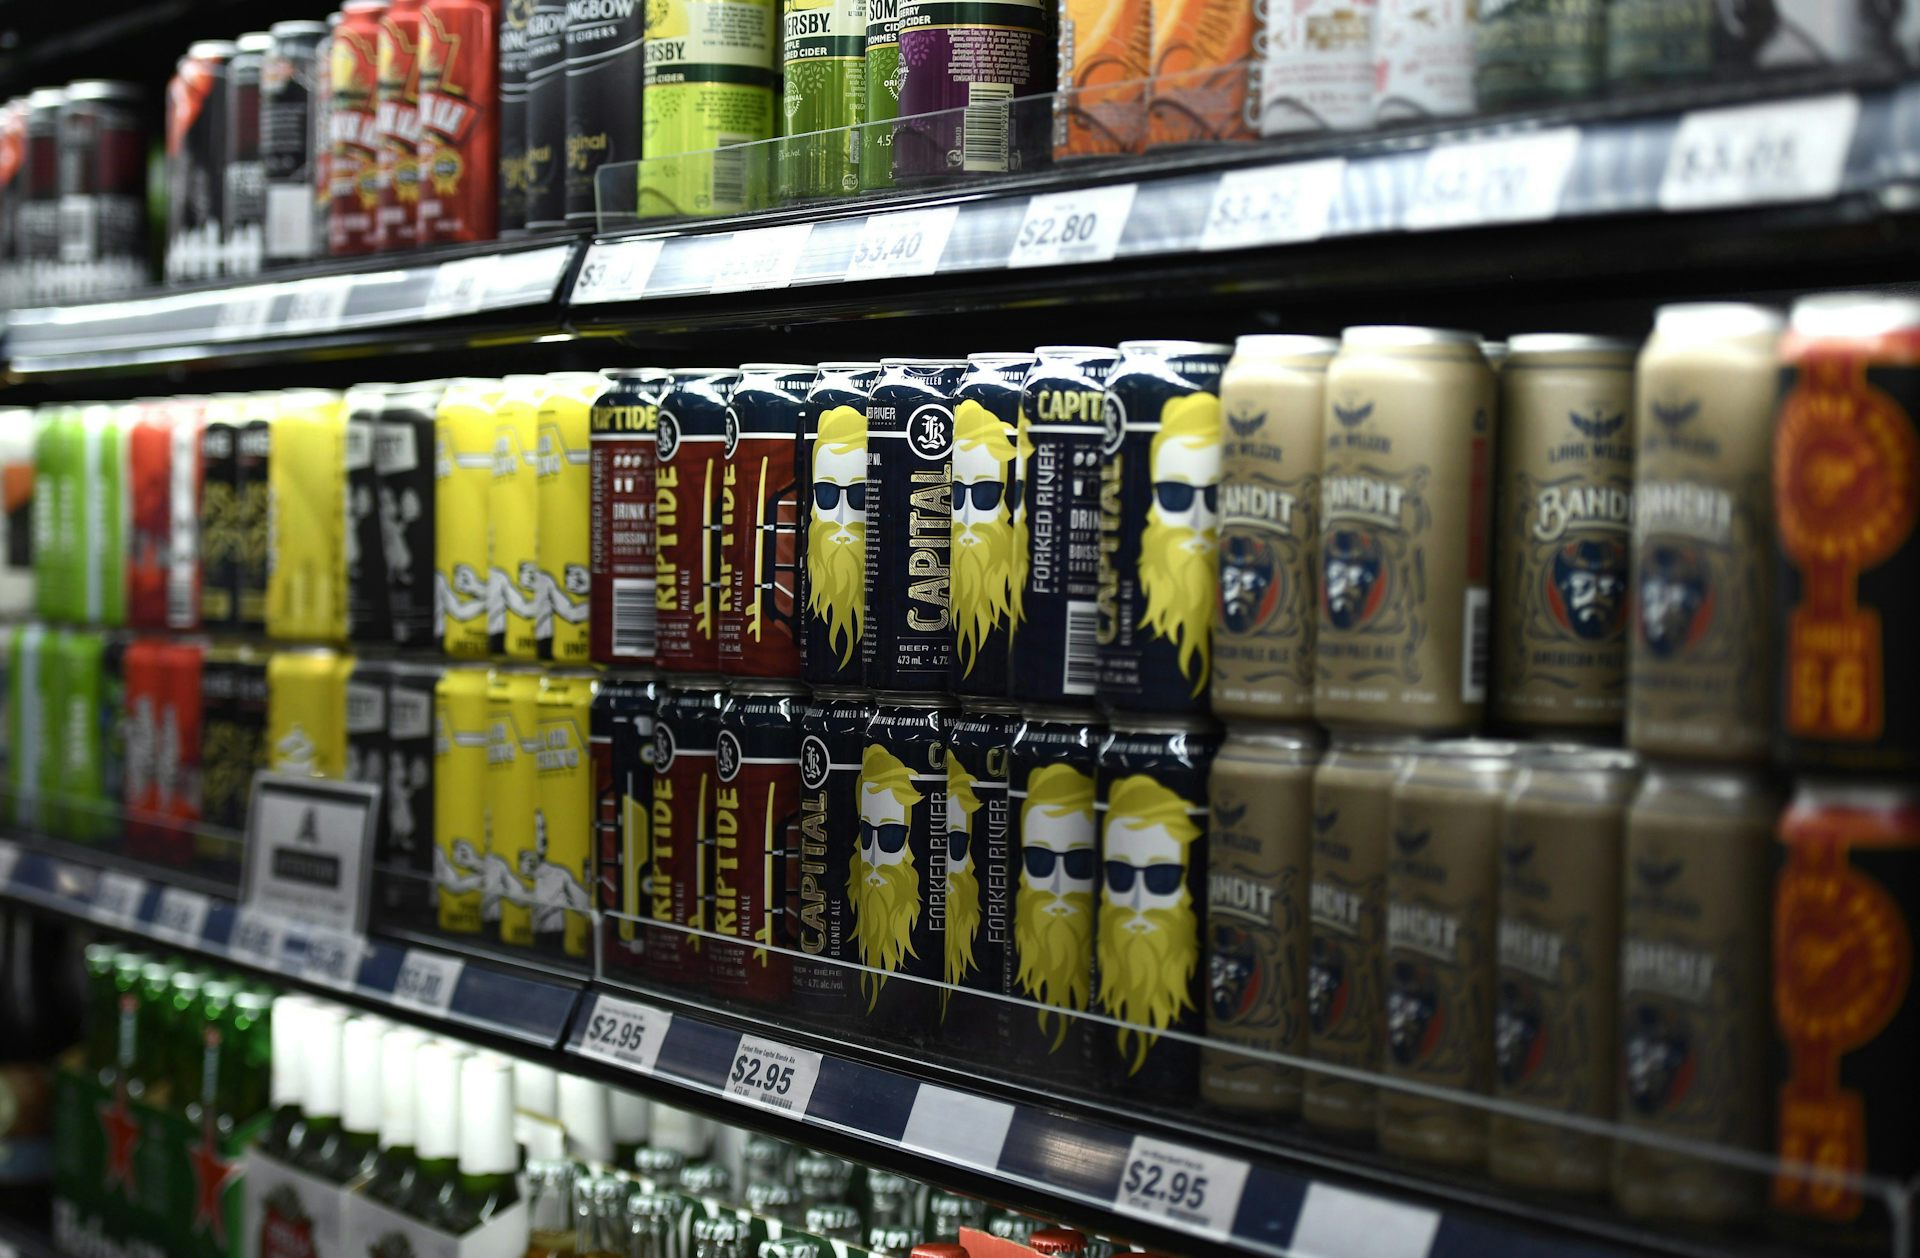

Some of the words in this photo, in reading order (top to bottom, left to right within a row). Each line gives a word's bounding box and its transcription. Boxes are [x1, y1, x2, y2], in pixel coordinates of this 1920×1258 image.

[907, 15, 931, 26] CIDER
[799, 47, 828, 56] CIDER
[1019, 212, 1097, 249] $2.80
[874, 407, 896, 420] RIVER
[1036, 443, 1056, 506] RIVER
[907, 460, 952, 632] CAPITAL
[1033, 510, 1053, 593] FORKED
[734, 570, 743, 587] ALE
[734, 591, 743, 612] PALE
[897, 655, 910, 665] 473
[911, 656, 922, 665] mL
[899, 644, 930, 652] BEER
[832, 708, 857, 719] FORKED
[897, 716, 929, 727] COMPANY
[930, 792, 947, 849] RIVER
[989, 799, 1009, 859] RIVER
[653, 779, 674, 921] RIPTIDE
[715, 787, 739, 935] RIPTIDE
[801, 790, 828, 954] CAPITAL
[741, 895, 751, 909] ALE
[830, 899, 841, 916] ALE
[929, 855, 946, 931] FORKED
[988, 864, 1007, 943] FORKED
[741, 911, 751, 937] PALE
[830, 920, 841, 956] BLONDE
[589, 1014, 646, 1051] $2.95
[731, 1054, 796, 1096] $2.95
[1124, 1159, 1209, 1210] $2.95
